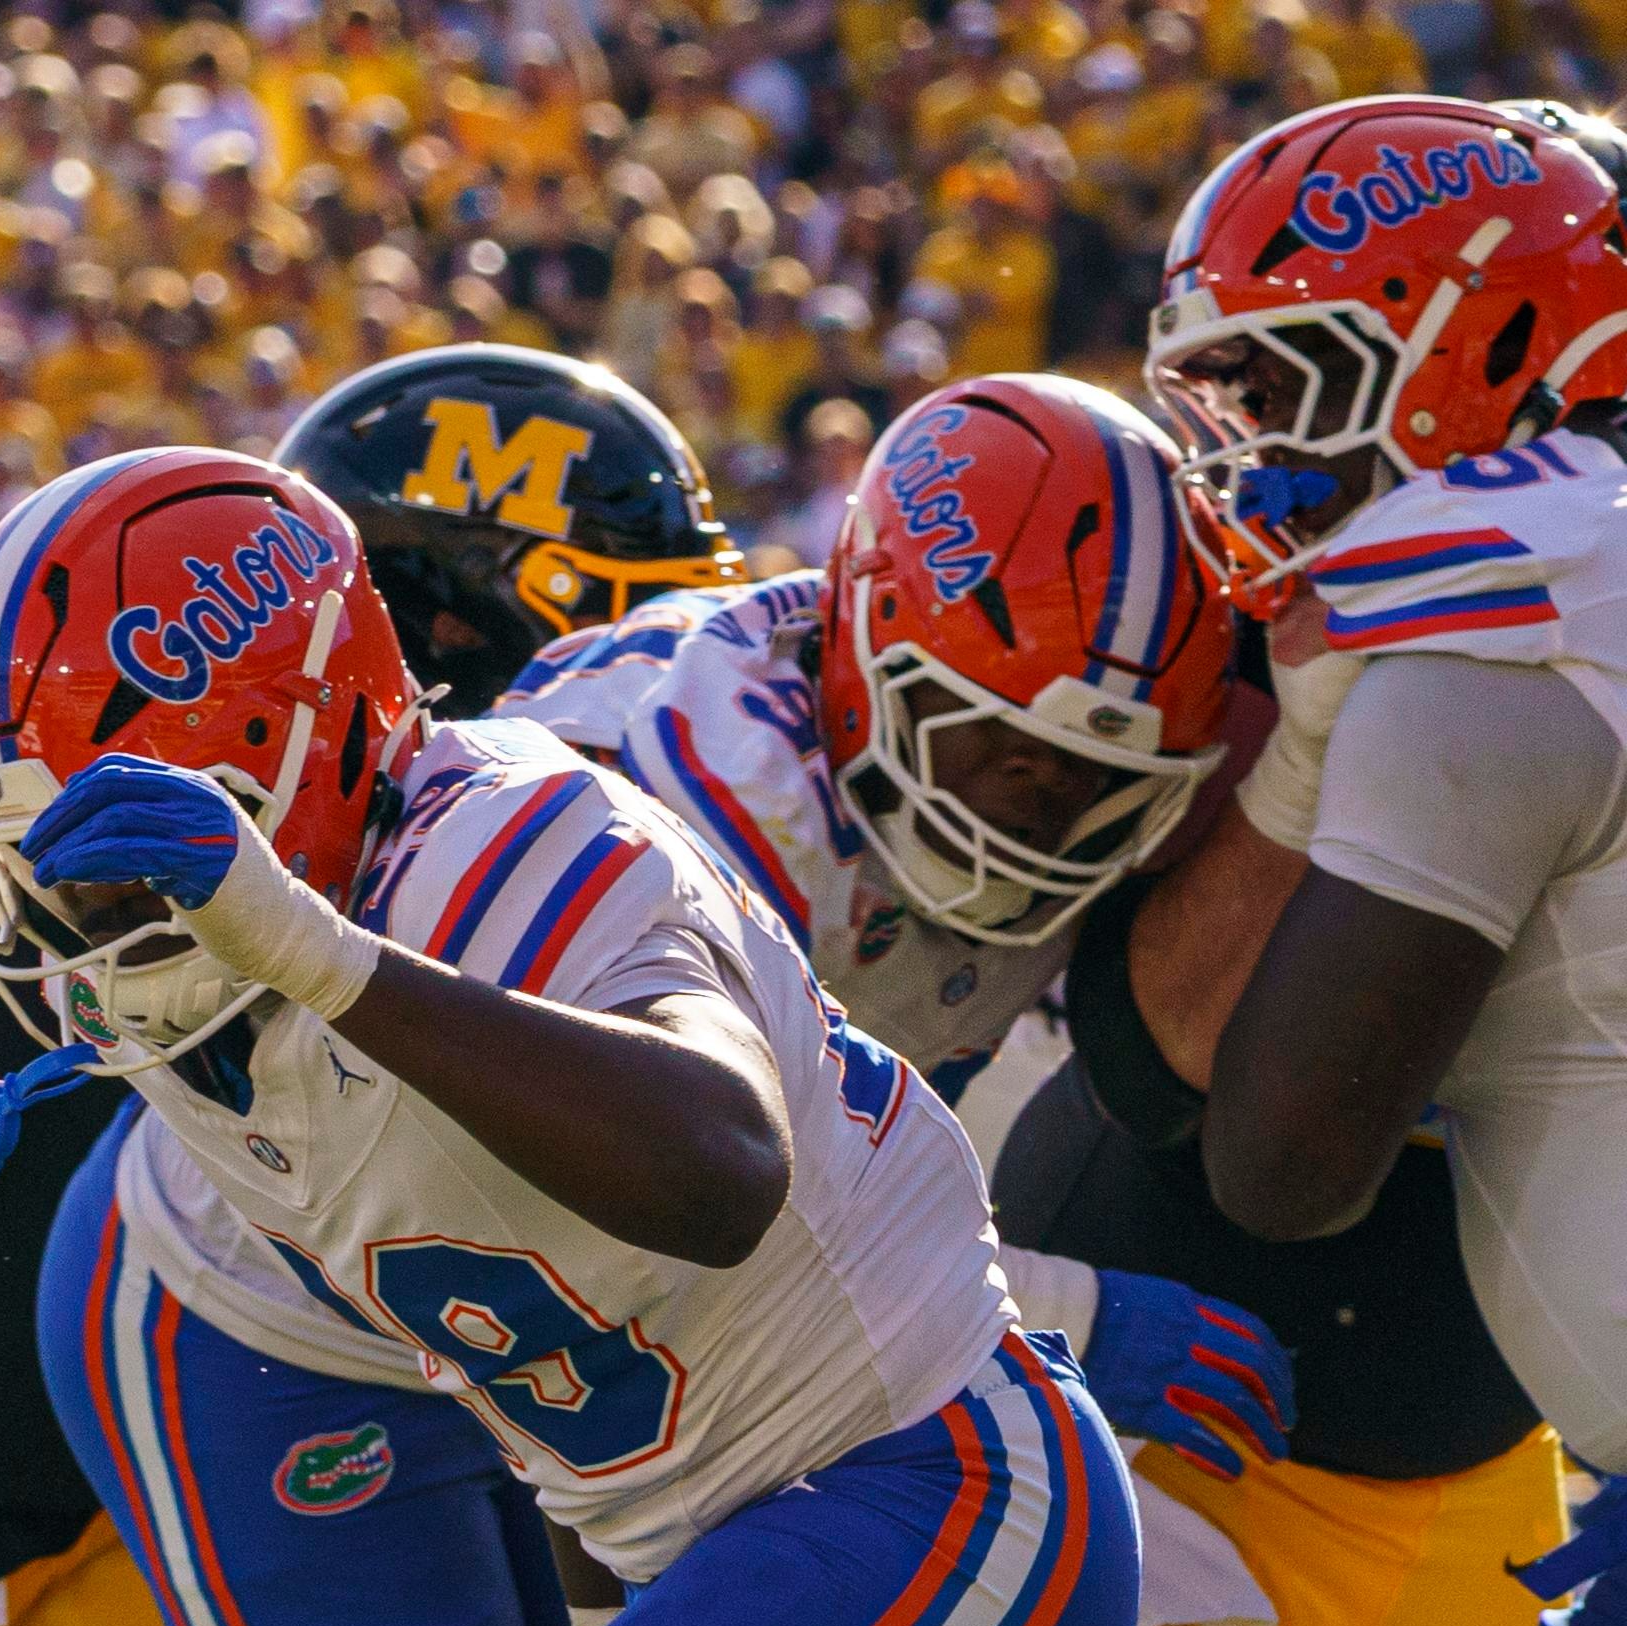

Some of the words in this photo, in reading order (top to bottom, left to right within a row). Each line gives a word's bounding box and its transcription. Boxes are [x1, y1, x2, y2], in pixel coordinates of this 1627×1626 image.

[1289, 139, 1543, 254] Gators
[401, 396, 596, 541] M
[884, 406, 994, 602] Gators
[108, 505, 335, 704] Gators
